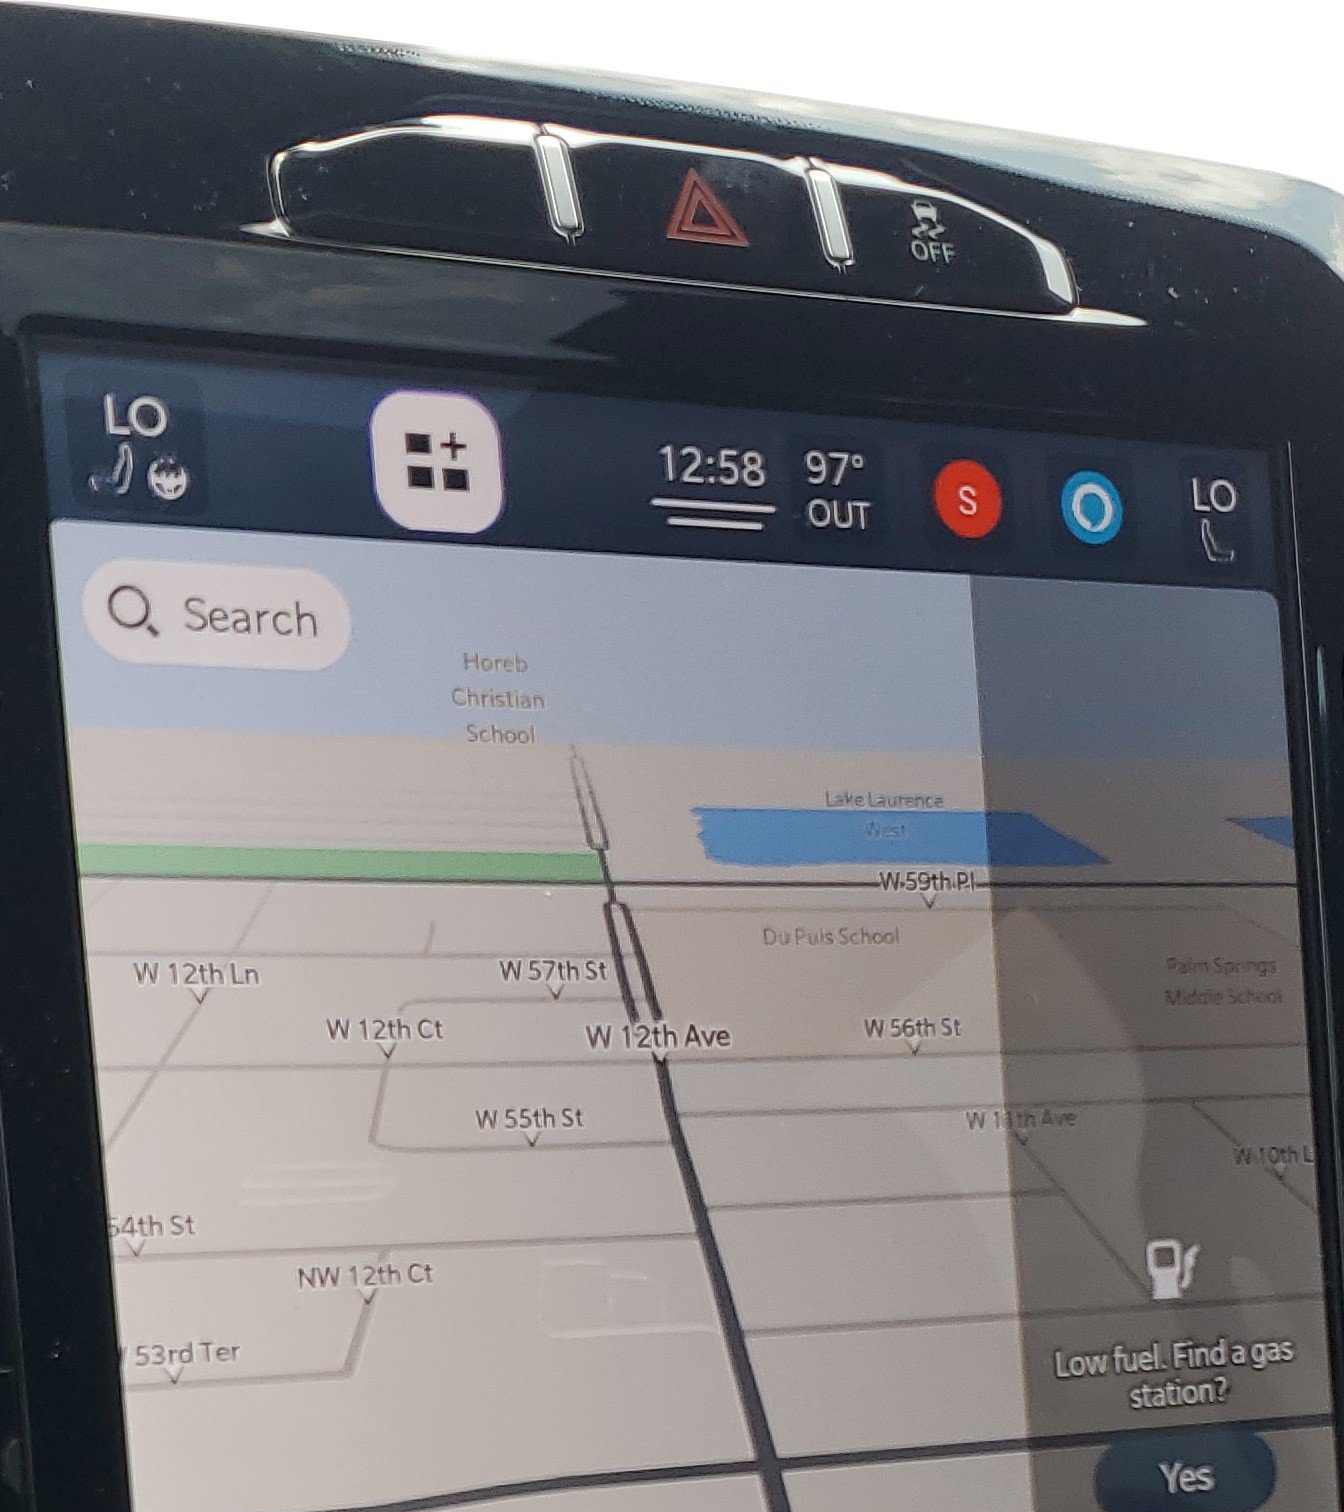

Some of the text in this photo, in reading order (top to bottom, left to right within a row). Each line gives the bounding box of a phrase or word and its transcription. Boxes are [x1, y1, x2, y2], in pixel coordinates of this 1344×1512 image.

[911, 239, 956, 264] OFF
[103, 393, 169, 437] LO
[659, 444, 766, 488] 12:58
[804, 451, 866, 487] 97°
[958, 485, 978, 517] S
[1191, 477, 1238, 513] LO
[808, 500, 871, 531] OUT
[183, 596, 319, 638] Search
[462, 651, 528, 673] Horeb
[451, 686, 546, 709] Christian
[466, 723, 535, 744] School
[825, 790, 865, 807] Lake
[879, 871, 901, 891] W
[905, 871, 952, 891] 59th
[763, 927, 791, 946] Du
[838, 926, 901, 947] School
[133, 962, 261, 985] W 12th Ln
[499, 960, 608, 982] W 57th St
[326, 1018, 444, 1041] W 12th Ct
[586, 1024, 731, 1049] W 12th Ave
[863, 1017, 961, 1038] W 56th St
[475, 1107, 584, 1130] W 55th St
[965, 1110, 986, 1130] W
[1235, 1147, 1252, 1165] W
[170, 1215, 196, 1236] St
[298, 1263, 433, 1289] NW 12th Ct
[135, 1342, 241, 1367] 53rd Ter
[1055, 1337, 1296, 1378] Low fuel. Find a gas
[1129, 1376, 1228, 1410] station?
[1158, 1459, 1216, 1495] Yes
